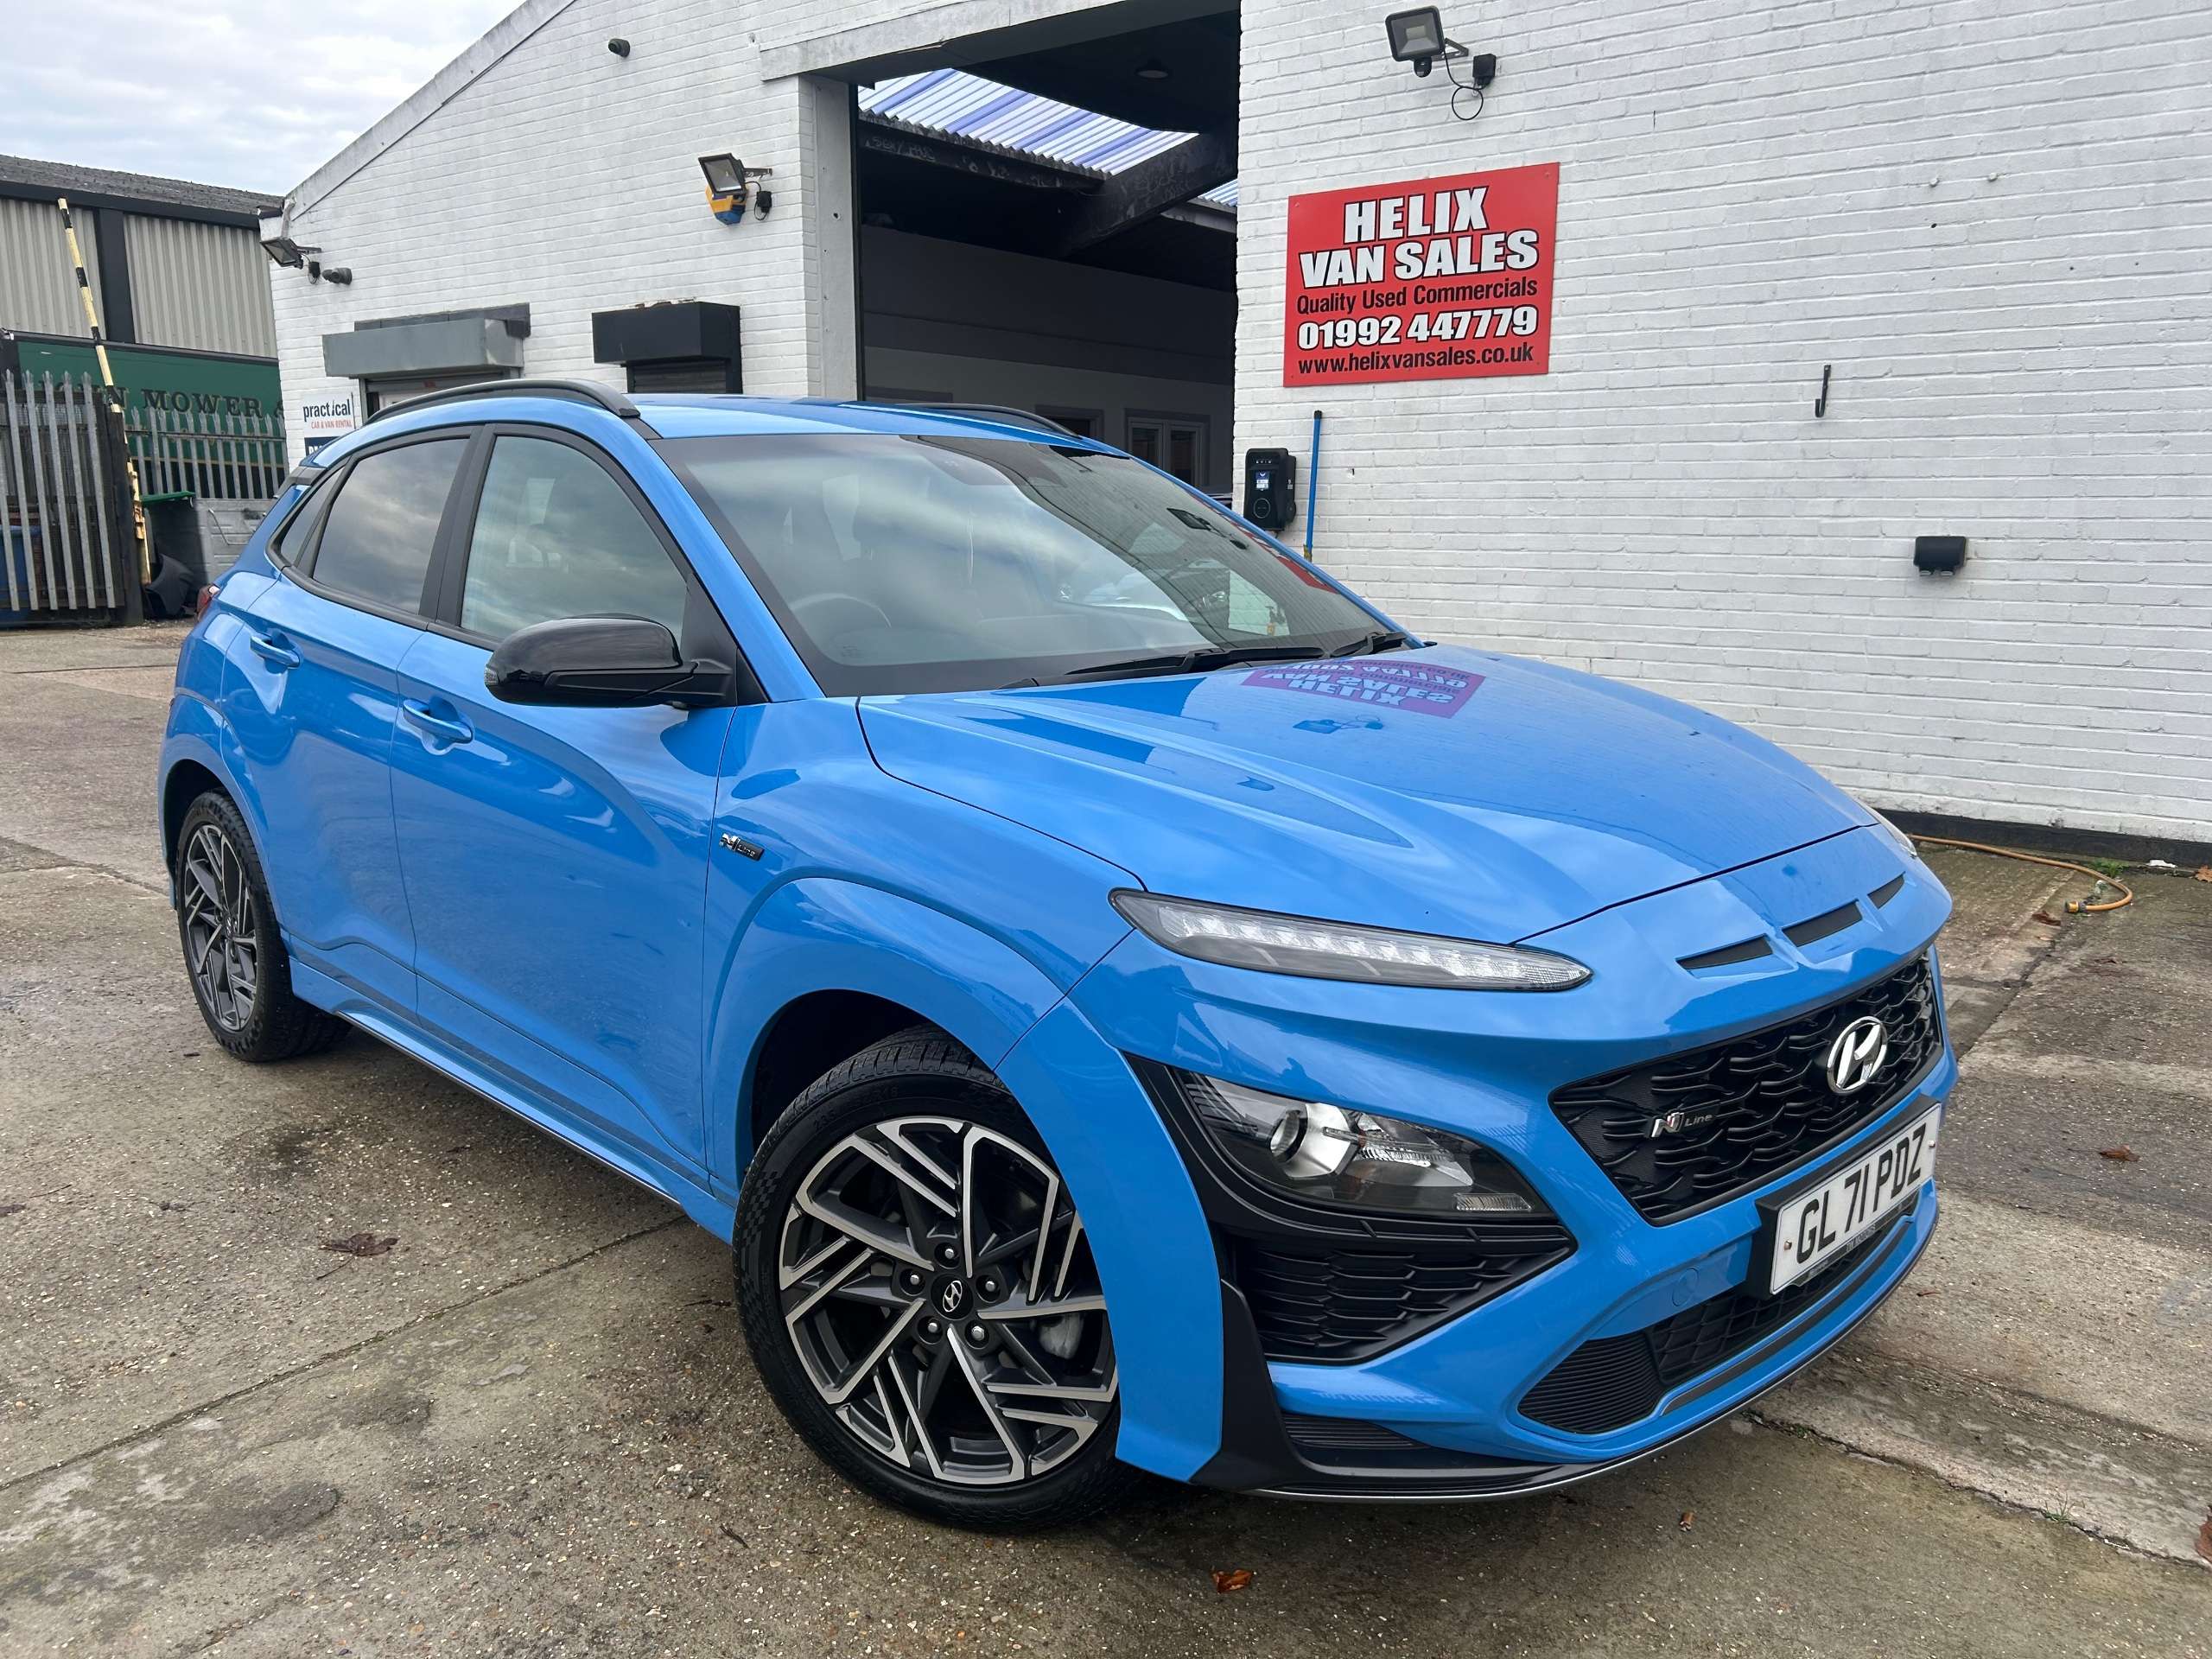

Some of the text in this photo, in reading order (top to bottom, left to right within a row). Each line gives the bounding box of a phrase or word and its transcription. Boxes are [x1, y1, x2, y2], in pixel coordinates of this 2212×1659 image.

[1344, 186, 1490, 245] HELIX
[1299, 228, 1539, 289] VAN SALES
[1297, 276, 1538, 315] Quality Used Commercials
[1297, 304, 1539, 351] 01992 447779
[1299, 342, 1534, 373] www.helixvansales.co.uk
[141, 388, 264, 419] MOWER
[302, 398, 351, 423] practical
[335, 418, 353, 429] RENTAL
[1684, 1114, 1713, 1127] Line
[1796, 1122, 1927, 1264] GL71 PDZ
